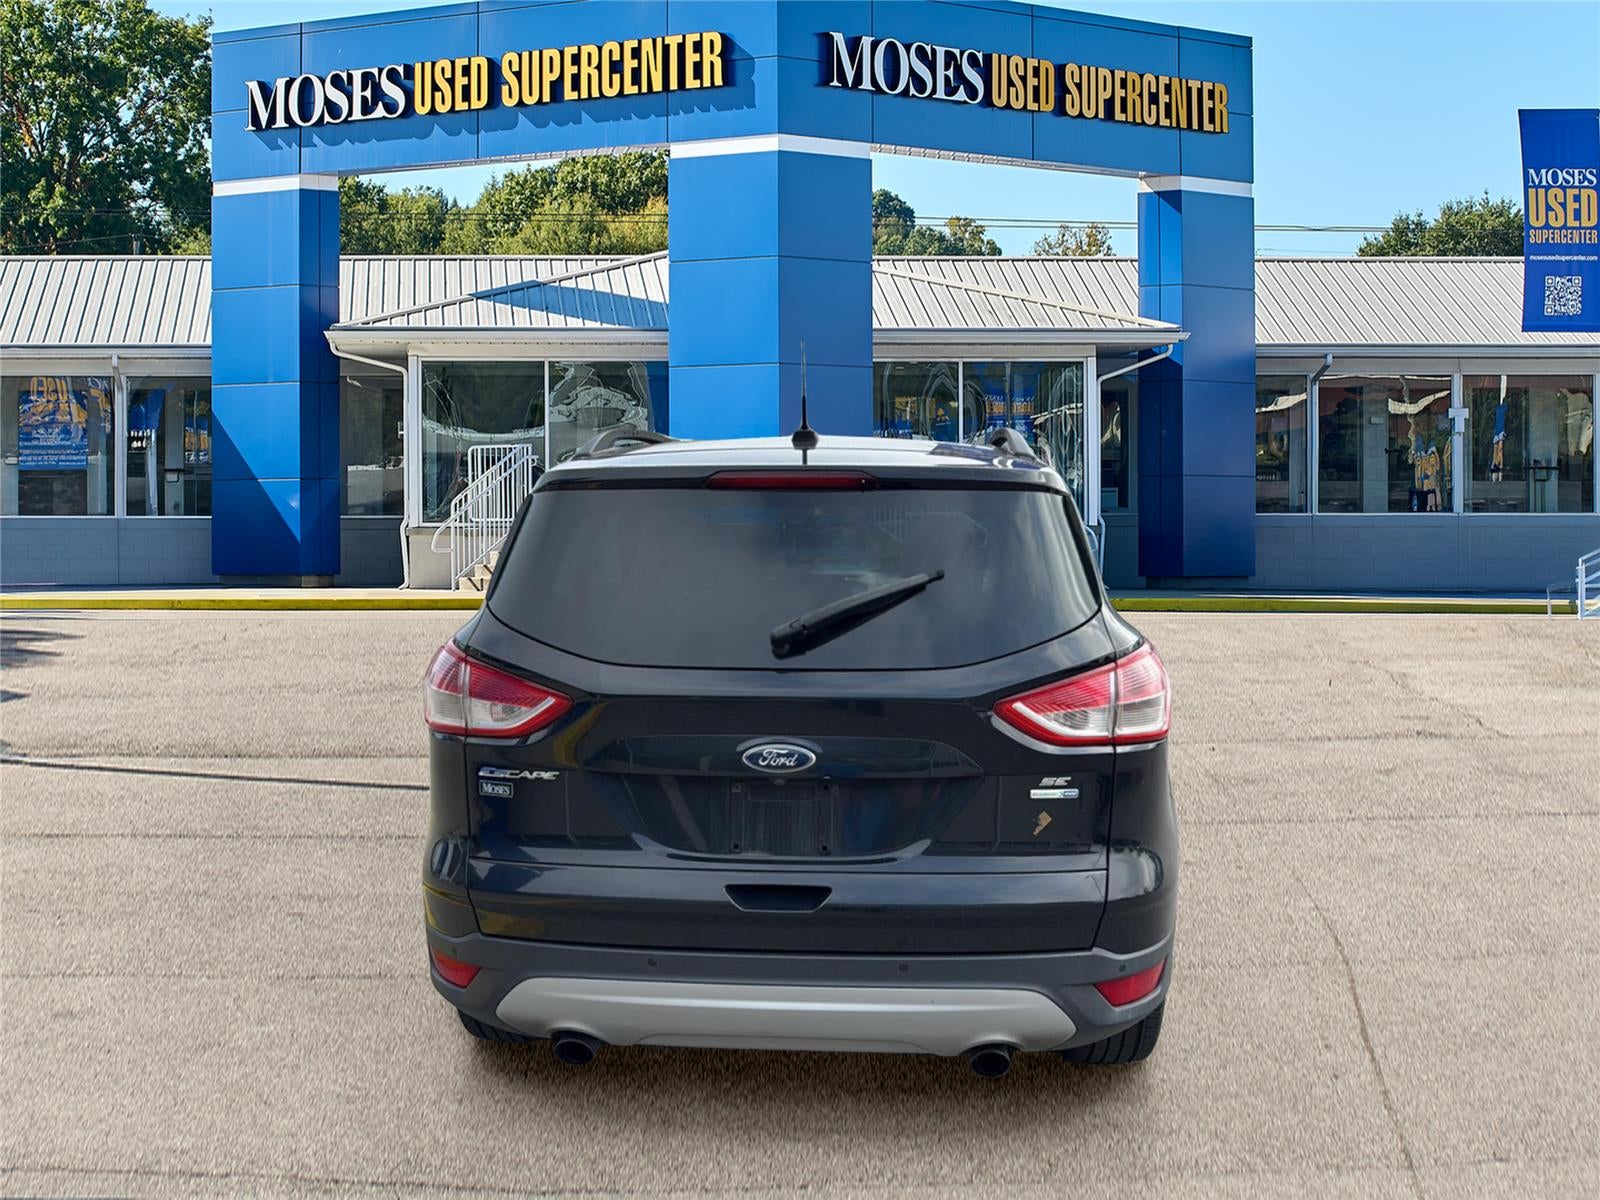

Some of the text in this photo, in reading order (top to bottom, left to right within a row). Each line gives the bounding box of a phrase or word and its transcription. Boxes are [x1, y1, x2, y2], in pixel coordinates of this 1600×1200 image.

[244, 31, 724, 132] MOSES USED SUPERCENTER
[829, 31, 1229, 134] MOSES USED SUPERCENTER
[1527, 168, 1597, 186] MOSES
[1528, 188, 1598, 227] USED
[1529, 229, 1598, 244] SUPERCENTER
[758, 748, 798, 766] Ford
[478, 766, 560, 780] ESCAPE
[481, 782, 511, 795] MOSES
